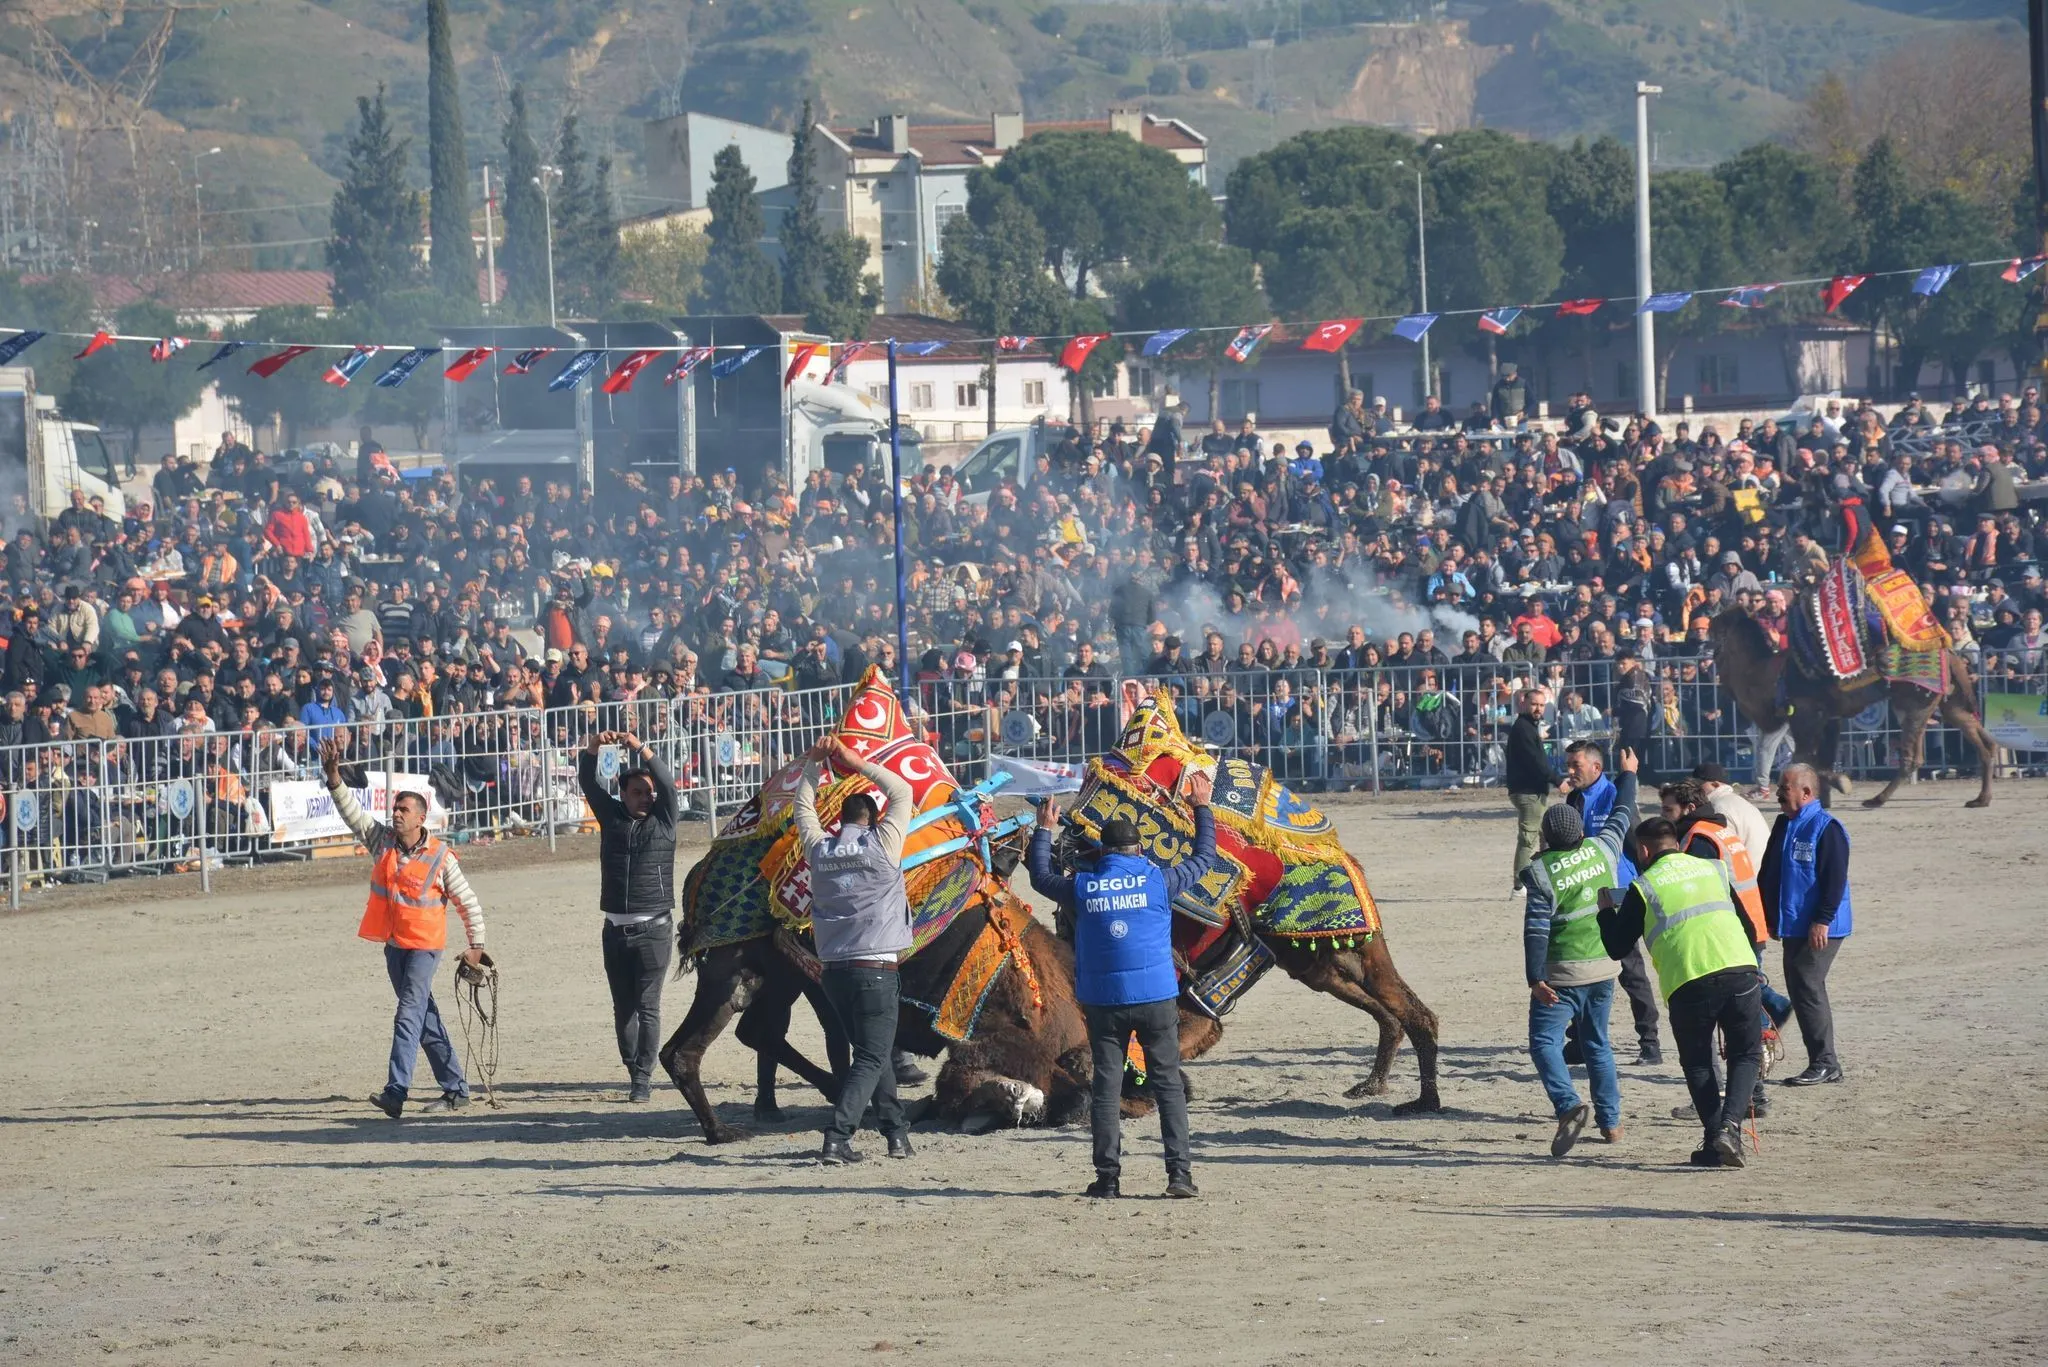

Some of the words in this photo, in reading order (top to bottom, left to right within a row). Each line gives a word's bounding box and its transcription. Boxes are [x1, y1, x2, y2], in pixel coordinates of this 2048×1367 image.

[1551, 846, 1597, 874] DEGÜF
[1087, 875, 1147, 893] DEGÜF
[1556, 862, 1606, 891] SAVRAN
[1086, 895, 1111, 913] ORTA
[1112, 893, 1148, 911] HAKEM
